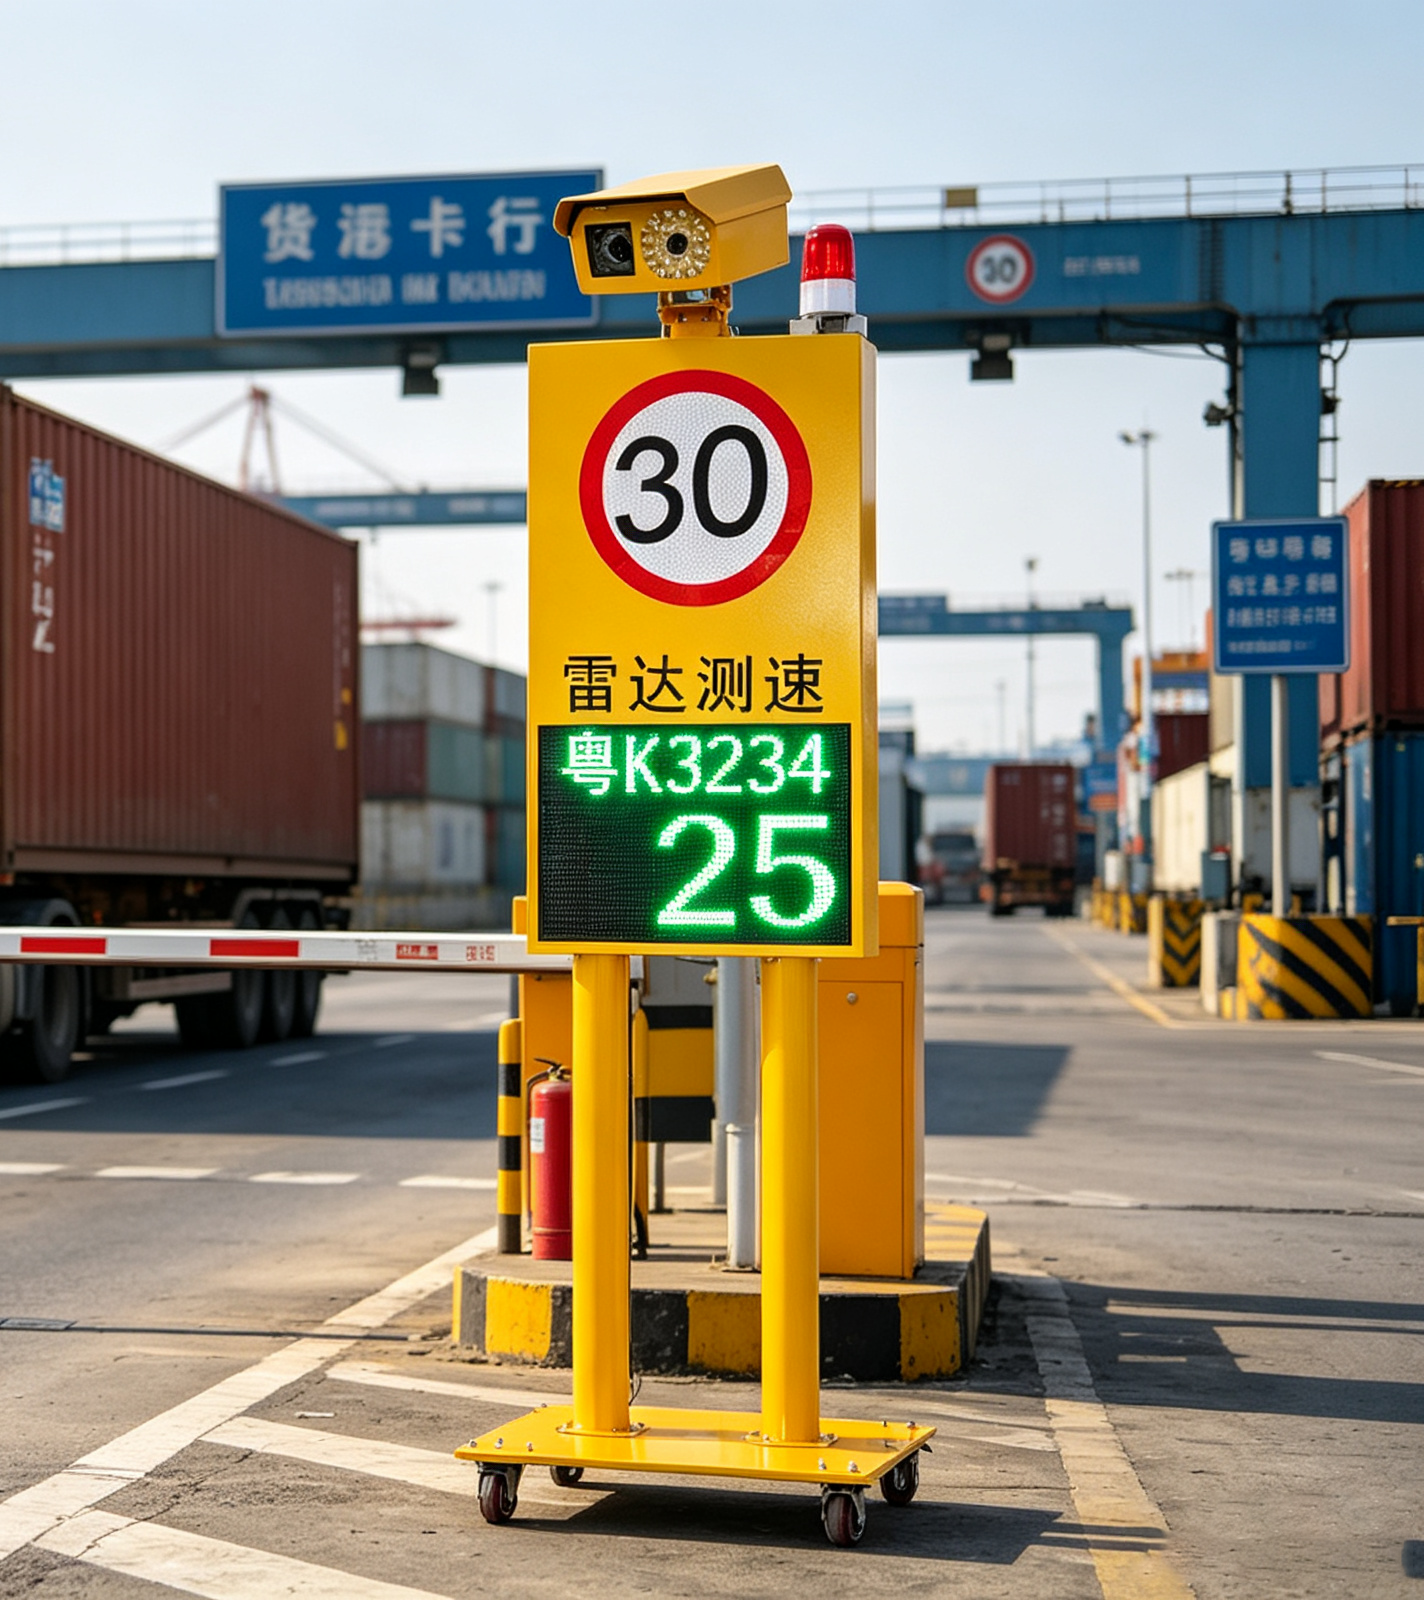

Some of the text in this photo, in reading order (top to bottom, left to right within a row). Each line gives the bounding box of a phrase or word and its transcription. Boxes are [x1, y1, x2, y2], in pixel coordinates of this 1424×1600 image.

[983, 255, 1018, 284] 30
[614, 425, 769, 544] 30
[563, 653, 825, 714] 雷达测速
[561, 731, 831, 797] 粤K3234
[656, 814, 837, 928] 25
